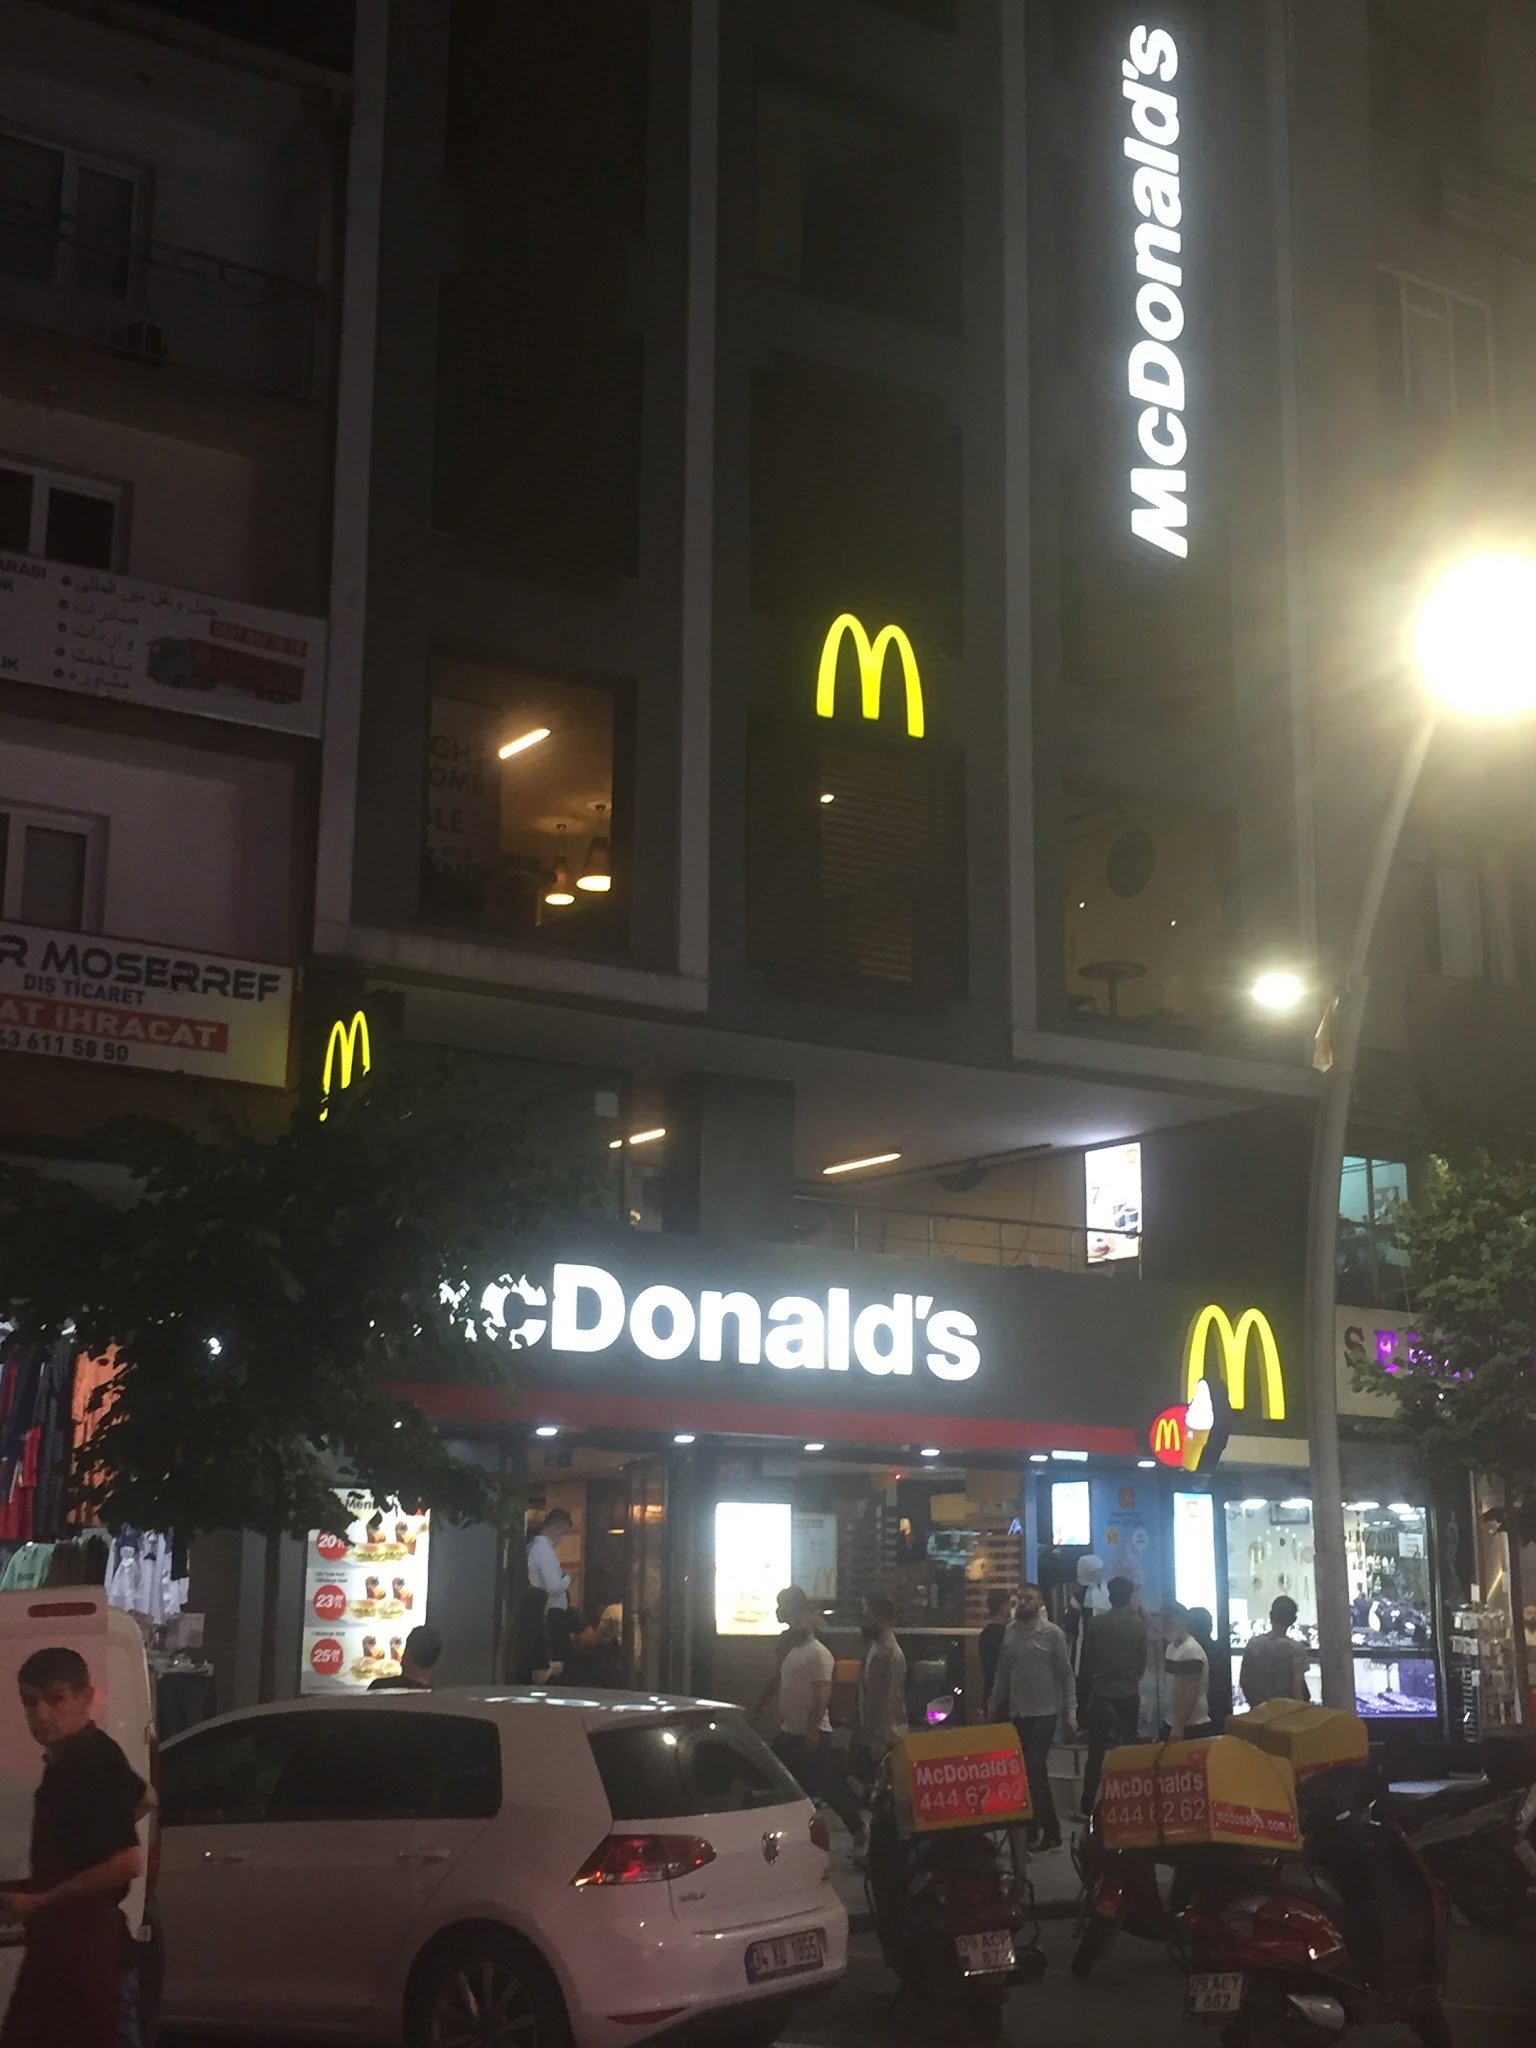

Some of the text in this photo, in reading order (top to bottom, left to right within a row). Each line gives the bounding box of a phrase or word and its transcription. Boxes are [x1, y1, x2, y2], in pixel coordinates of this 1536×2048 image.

[1122, 24, 1190, 560] McDonald's
[40, 940, 282, 1001] MOSERREF
[437, 1262, 982, 1382] cDonald's
[915, 1756, 1021, 1787] McDonald's
[920, 1780, 1023, 1811] 444 62 62
[1105, 1803, 1144, 1826] 444
[1180, 1799, 1206, 1822] 62
